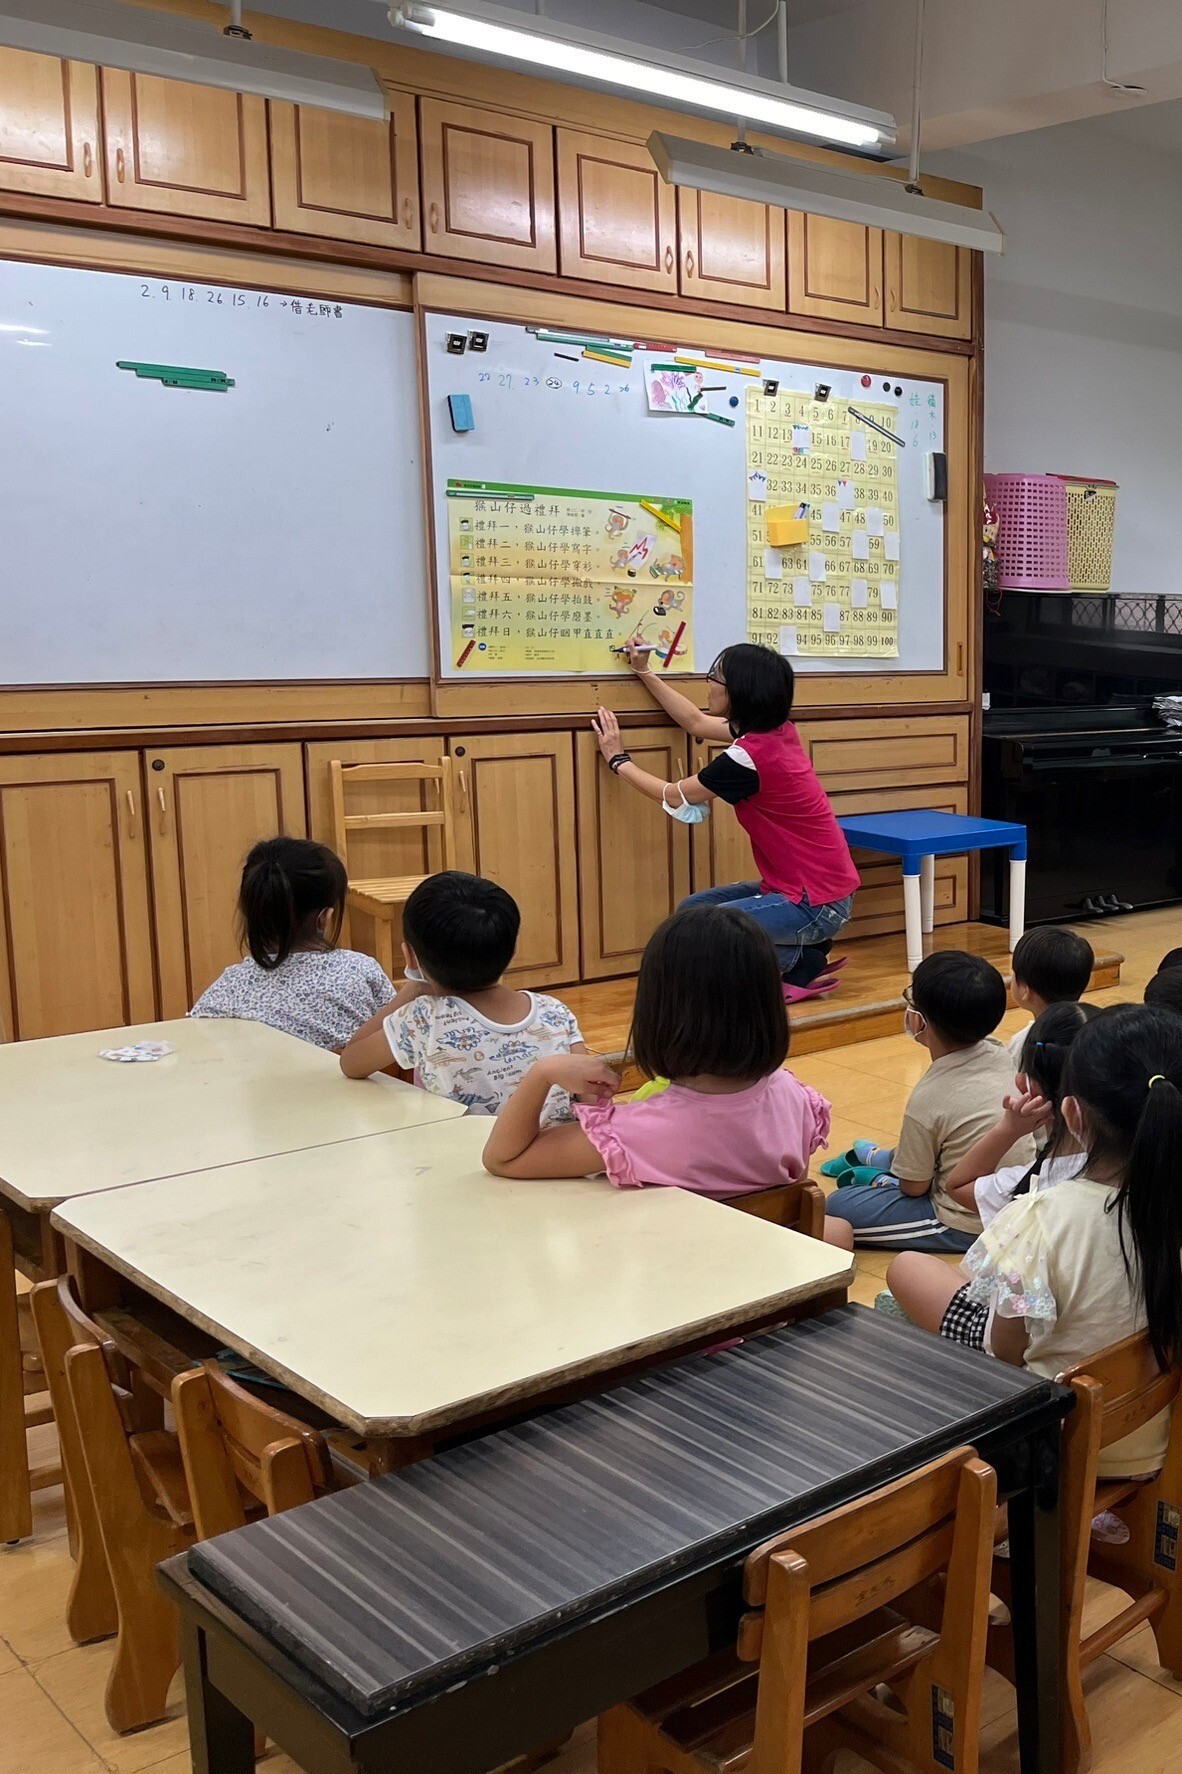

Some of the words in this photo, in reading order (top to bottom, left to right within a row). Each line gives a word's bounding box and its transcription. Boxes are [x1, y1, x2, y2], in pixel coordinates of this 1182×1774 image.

[573, 381, 580, 394] 9
[587, 382, 595, 395] 5
[604, 384, 610, 395] 2
[756, 399, 759, 410] 1
[771, 401, 776, 412] 2
[785, 403, 791, 414] 3
[799, 406, 804, 416] 4
[814, 407, 819, 418] 5
[828, 410, 833, 420] 6
[843, 411, 847, 422] 7
[882, 417, 891, 428] 10
[753, 426, 763, 437] 11
[768, 427, 778, 439] 12
[782, 429, 792, 441] 13
[812, 433, 822, 444] 15
[827, 435, 836, 446] 16
[841, 436, 850, 447] 17
[868, 440, 877, 451] 19
[882, 442, 891, 453] 20
[752, 452, 762, 463] 21
[767, 453, 778, 465] 22
[782, 455, 793, 466] 23
[796, 457, 807, 468] 24
[811, 458, 822, 470] 25
[826, 460, 836, 472] 26
[840, 461, 850, 473] 27
[854, 463, 865, 474] 28
[868, 464, 879, 476] 29
[883, 466, 892, 477] 30
[767, 479, 778, 491] 32
[781, 481, 793, 492] 33
[796, 482, 807, 494] 34
[811, 484, 822, 495] 35
[825, 485, 836, 497] 36
[854, 488, 865, 499] 38
[868, 489, 879, 500] 39
[883, 491, 893, 502] 40
[475, 500, 560, 517] 猴山仔過禮拜
[752, 504, 762, 516] 41
[811, 510, 822, 521] 45
[840, 512, 851, 523] 47
[854, 514, 865, 524] 48
[884, 516, 893, 526] 50
[753, 530, 762, 541] 51
[811, 535, 821, 546] 55
[825, 536, 836, 547] 56
[840, 537, 851, 548] 57
[869, 539, 879, 549] 59
[753, 557, 763, 567] 61
[782, 558, 793, 569] 63
[796, 559, 807, 570] 64
[825, 561, 836, 572] 66
[840, 562, 851, 572] 67
[854, 562, 865, 573] 68
[869, 563, 879, 574] 69
[883, 564, 894, 574] 70
[753, 582, 763, 593] 71
[768, 583, 778, 594] 72
[783, 583, 793, 594] 73
[812, 585, 822, 596] 75
[826, 586, 836, 596] 76
[840, 586, 850, 596] 77
[868, 587, 878, 598] 79
[753, 607, 763, 619] 81
[767, 608, 779, 619] 82
[782, 608, 793, 620] 83
[797, 609, 807, 620] 84
[811, 610, 822, 621] 85
[840, 610, 850, 621] 87
[853, 611, 864, 622] 88
[867, 612, 878, 622] 89
[882, 612, 892, 623] 90
[752, 633, 762, 644] 91
[767, 633, 778, 645] 92
[797, 634, 807, 645] 94
[811, 635, 821, 645] 95
[825, 635, 836, 646] 96
[840, 635, 850, 646] 97
[854, 635, 864, 646] 98
[867, 636, 878, 646] 99
[881, 637, 893, 646] 100
